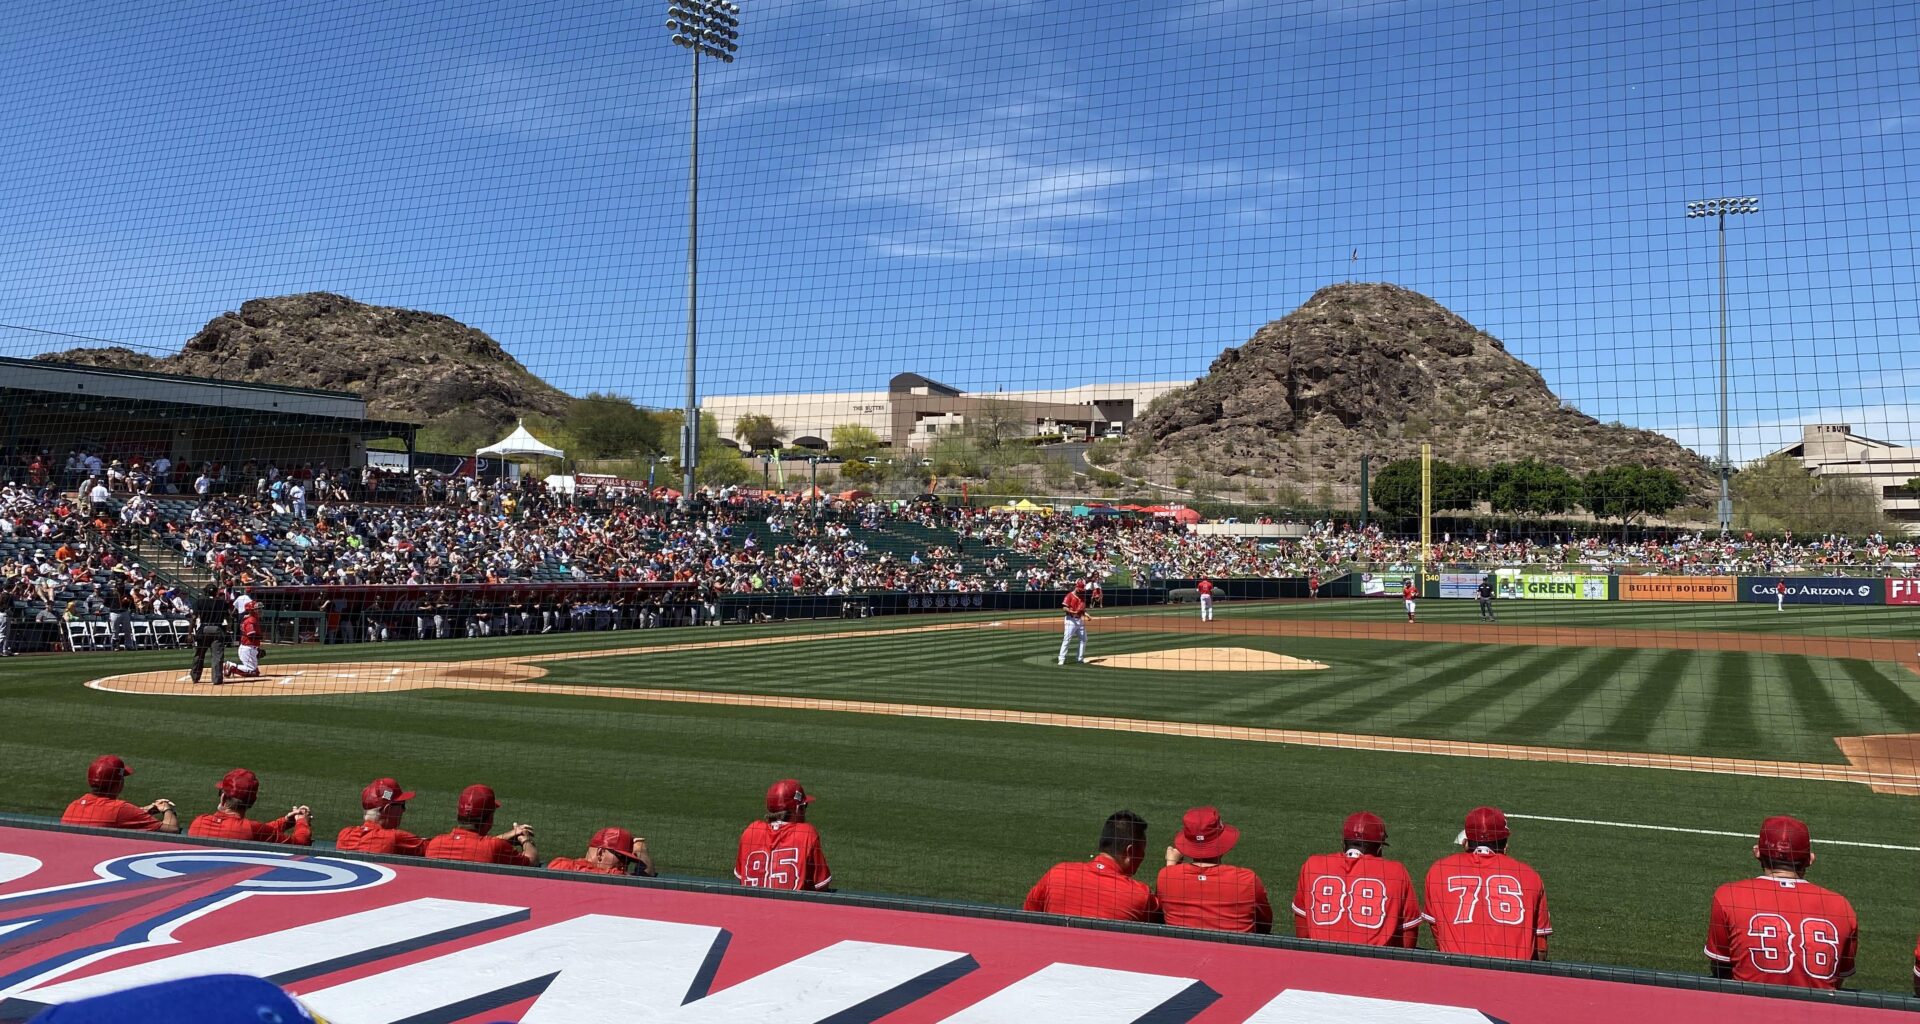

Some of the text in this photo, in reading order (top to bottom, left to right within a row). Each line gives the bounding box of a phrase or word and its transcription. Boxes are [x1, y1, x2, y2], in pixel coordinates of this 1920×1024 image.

[1817, 425, 1830, 433] TE
[1425, 574, 1439, 582] 340
[1528, 583, 1576, 593] GREEN
[1628, 584, 1728, 593] BULLEIT BOURBON
[744, 847, 799, 891] 95
[1311, 874, 1388, 929] 88
[1448, 874, 1525, 925] 76
[1747, 912, 1839, 980] 36
